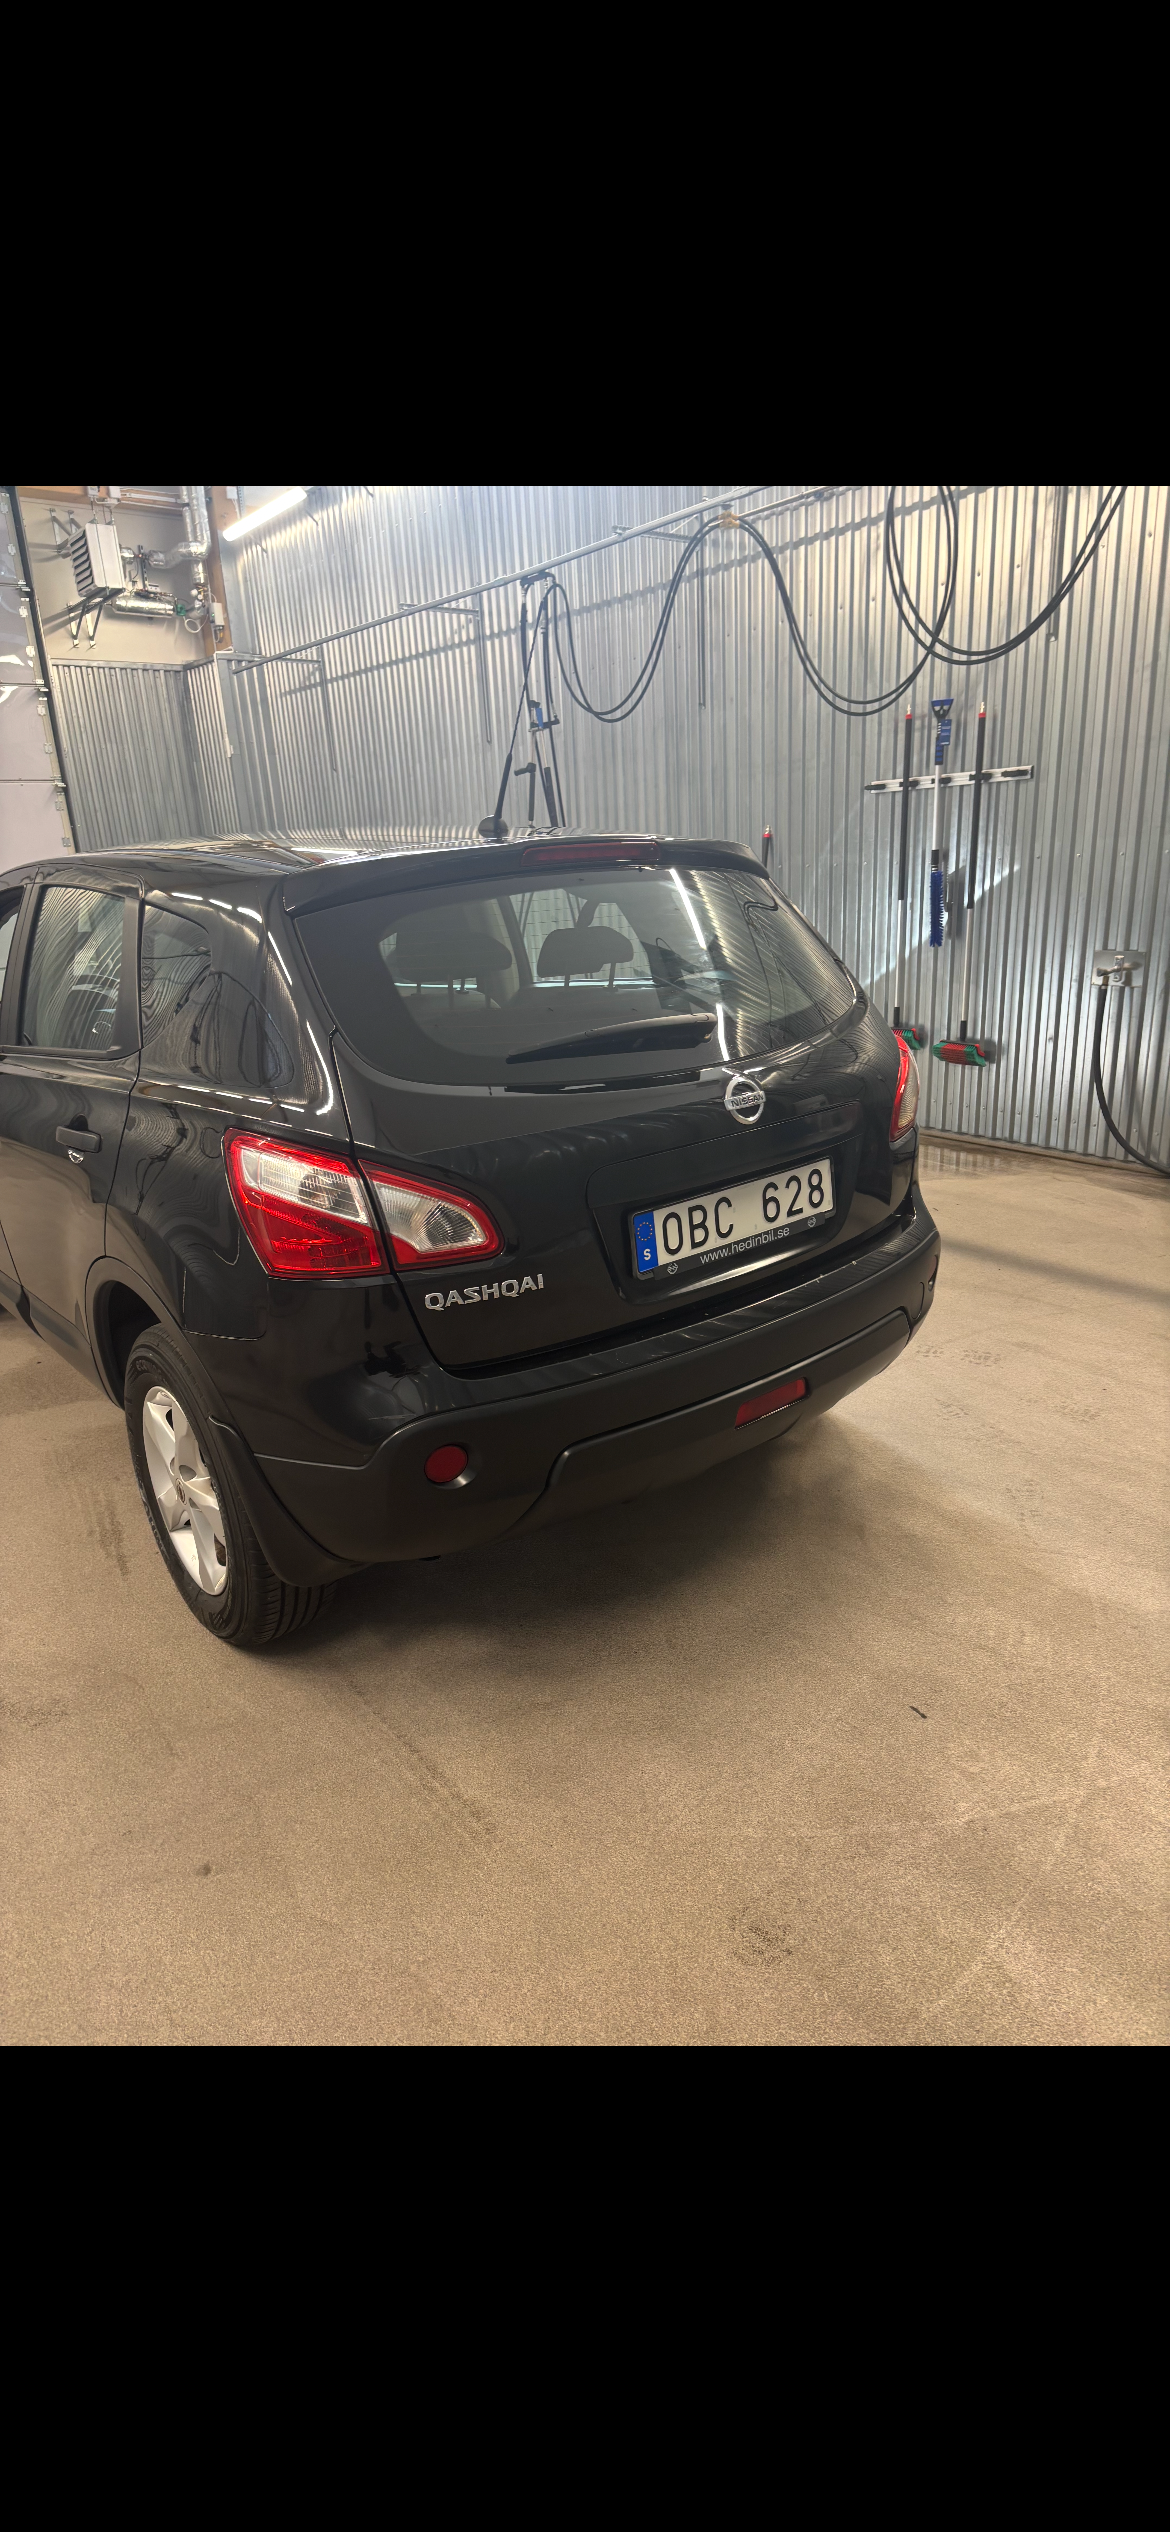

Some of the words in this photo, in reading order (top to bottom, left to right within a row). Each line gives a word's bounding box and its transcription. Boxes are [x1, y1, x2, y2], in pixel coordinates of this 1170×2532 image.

[730, 1093, 764, 1107] NISSAN
[662, 1196, 734, 1256] OBC
[762, 1168, 825, 1223] 628
[643, 1248, 652, 1262] S
[699, 1225, 790, 1265] www.hedinbil.se
[424, 1273, 545, 1311] QASHQAI
